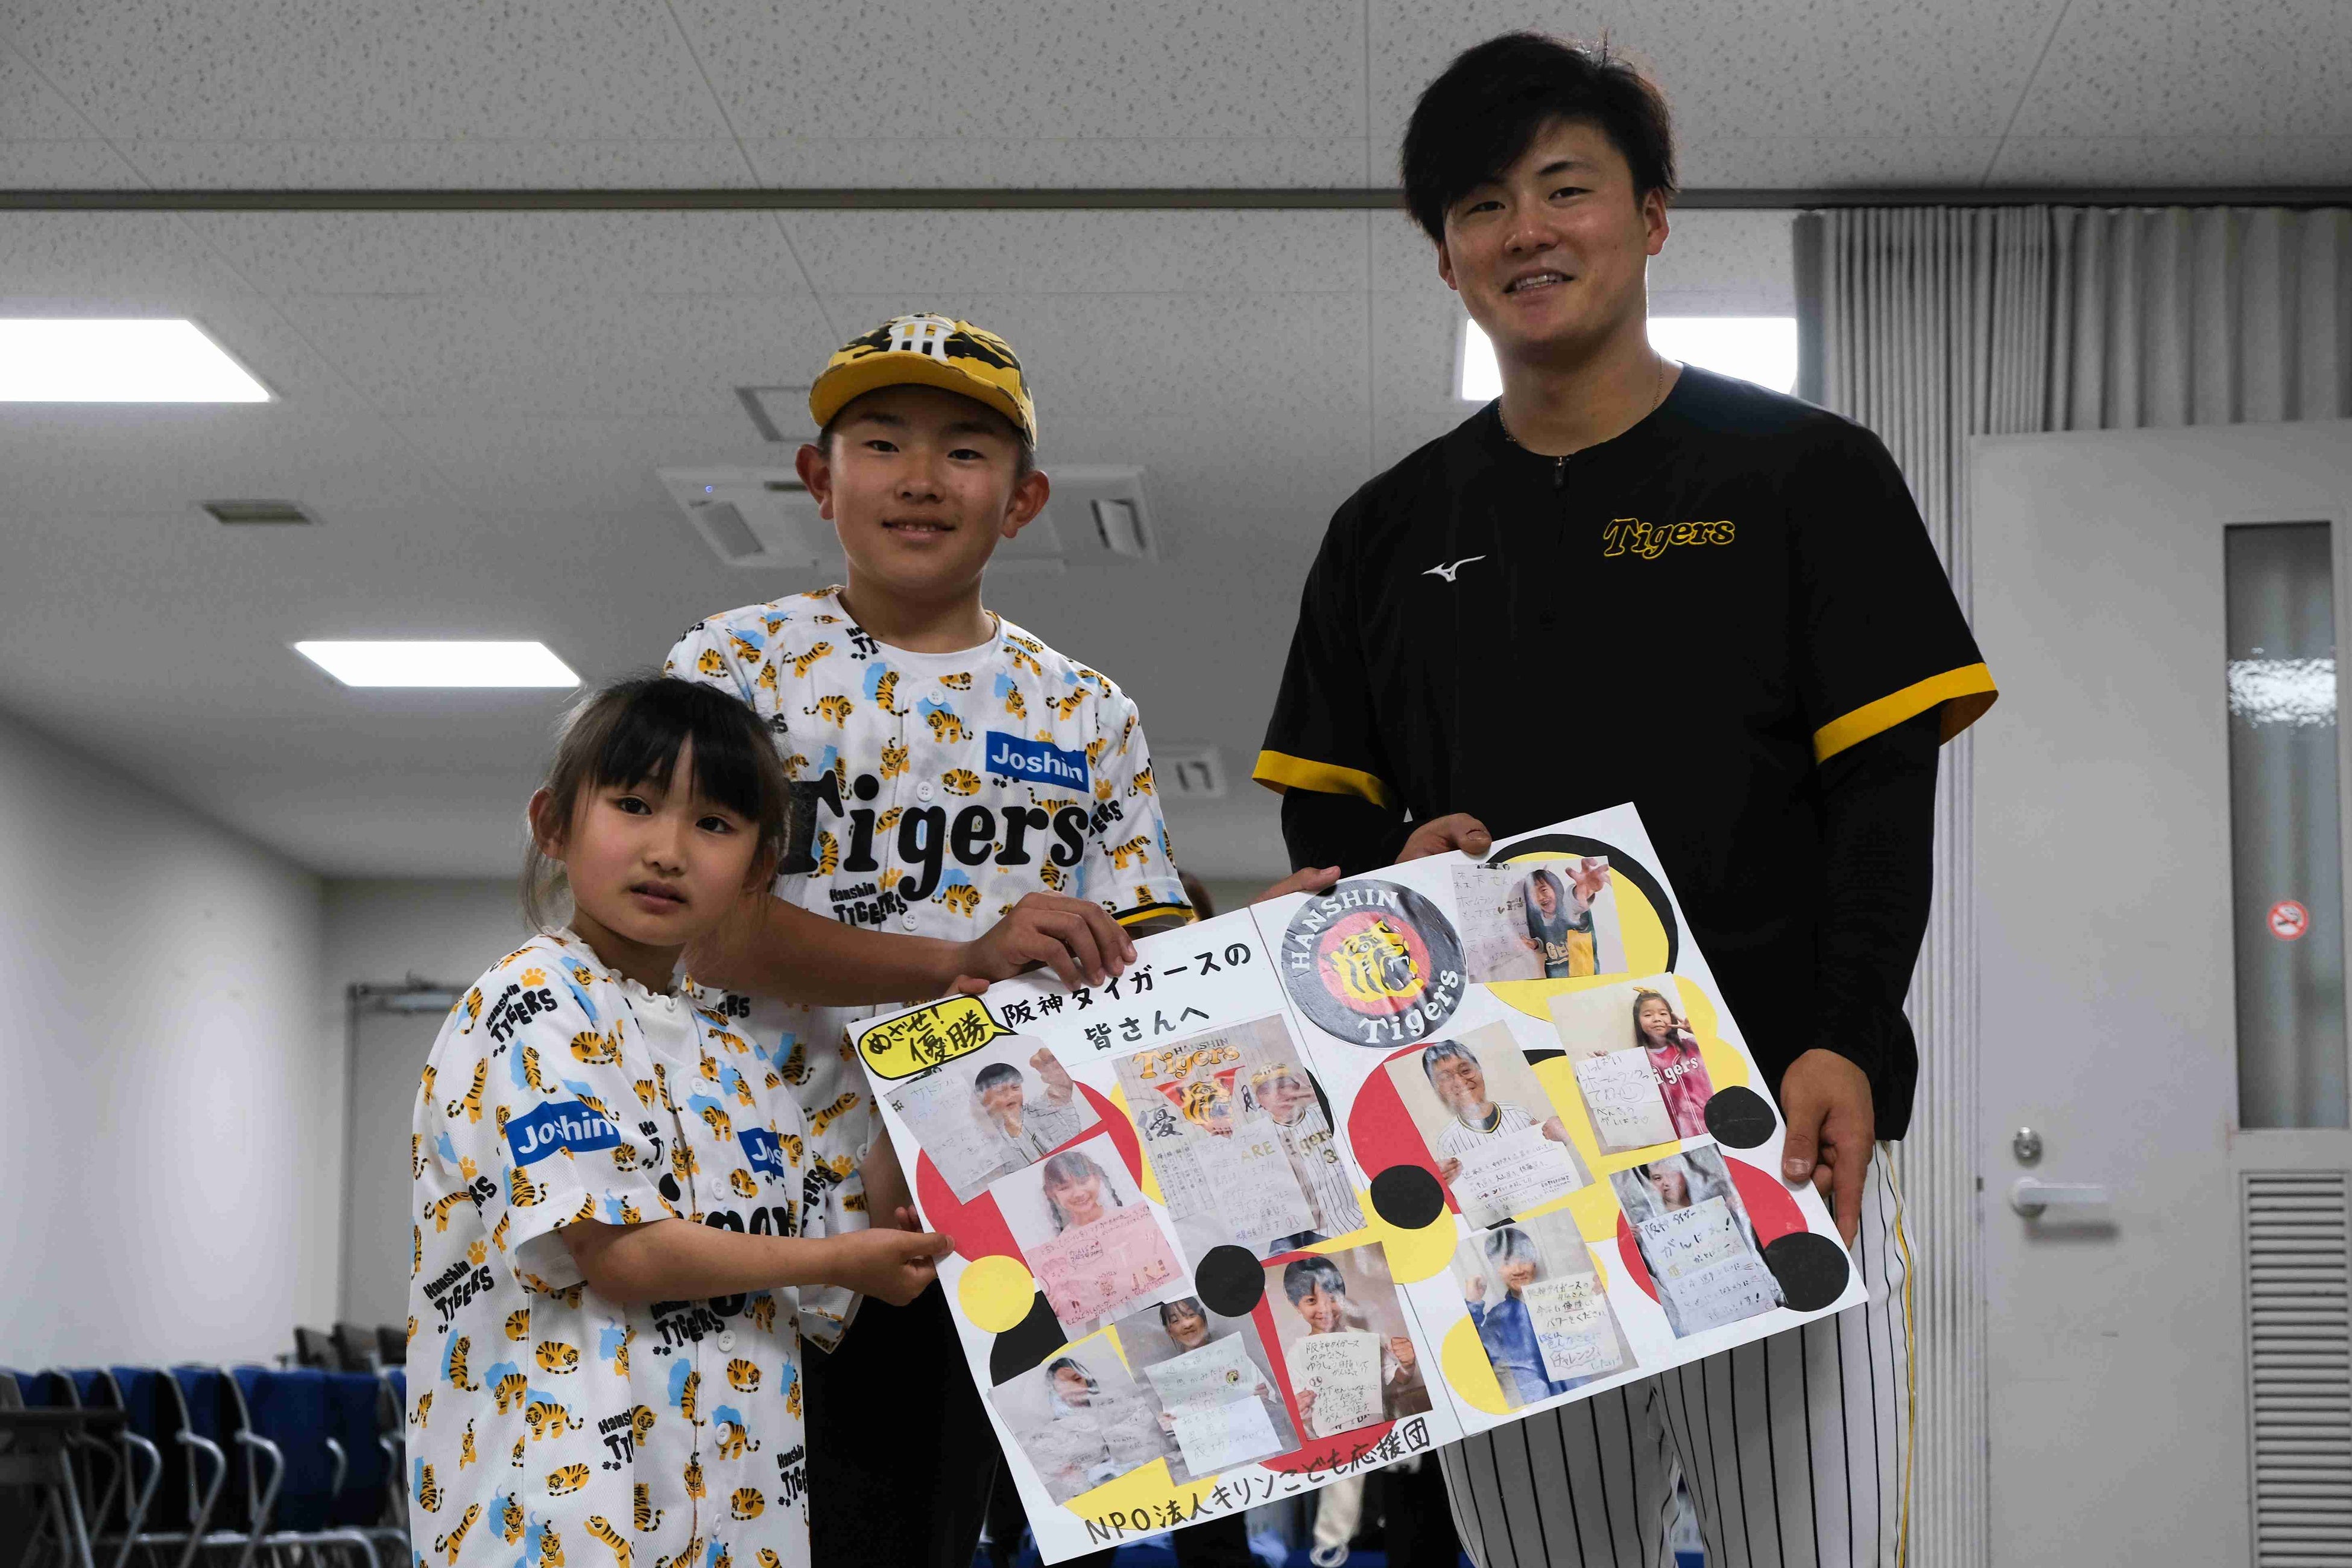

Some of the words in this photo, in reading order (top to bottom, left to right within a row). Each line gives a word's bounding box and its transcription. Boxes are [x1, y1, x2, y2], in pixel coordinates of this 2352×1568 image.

[1603, 517, 1736, 560] Tigers
[991, 742, 1084, 783] Joshin
[779, 770, 1089, 902] Tigers
[829, 882, 877, 903] Hanshin
[833, 891, 908, 926] TIGERS
[1291, 888, 1399, 970] HANSHIN
[485, 984, 521, 1030] Hanshin
[1000, 943, 1252, 1029] 阪神タイガースの
[1358, 970, 1459, 1044] Tigers
[490, 988, 558, 1043] TIGERS
[909, 1009, 990, 1065] 優勝
[1084, 1006, 1210, 1051] 皆さんへ
[1132, 1044, 1241, 1080] Tigers
[1174, 1037, 1230, 1055] HANSHIN
[1241, 1140, 1276, 1165] ARE
[423, 1260, 471, 1300] Hanshin
[434, 1265, 495, 1322] TIGERS
[655, 1307, 725, 1347] TIGERS
[1084, 1417, 1431, 1545] NPO法人キリンこども応援団
